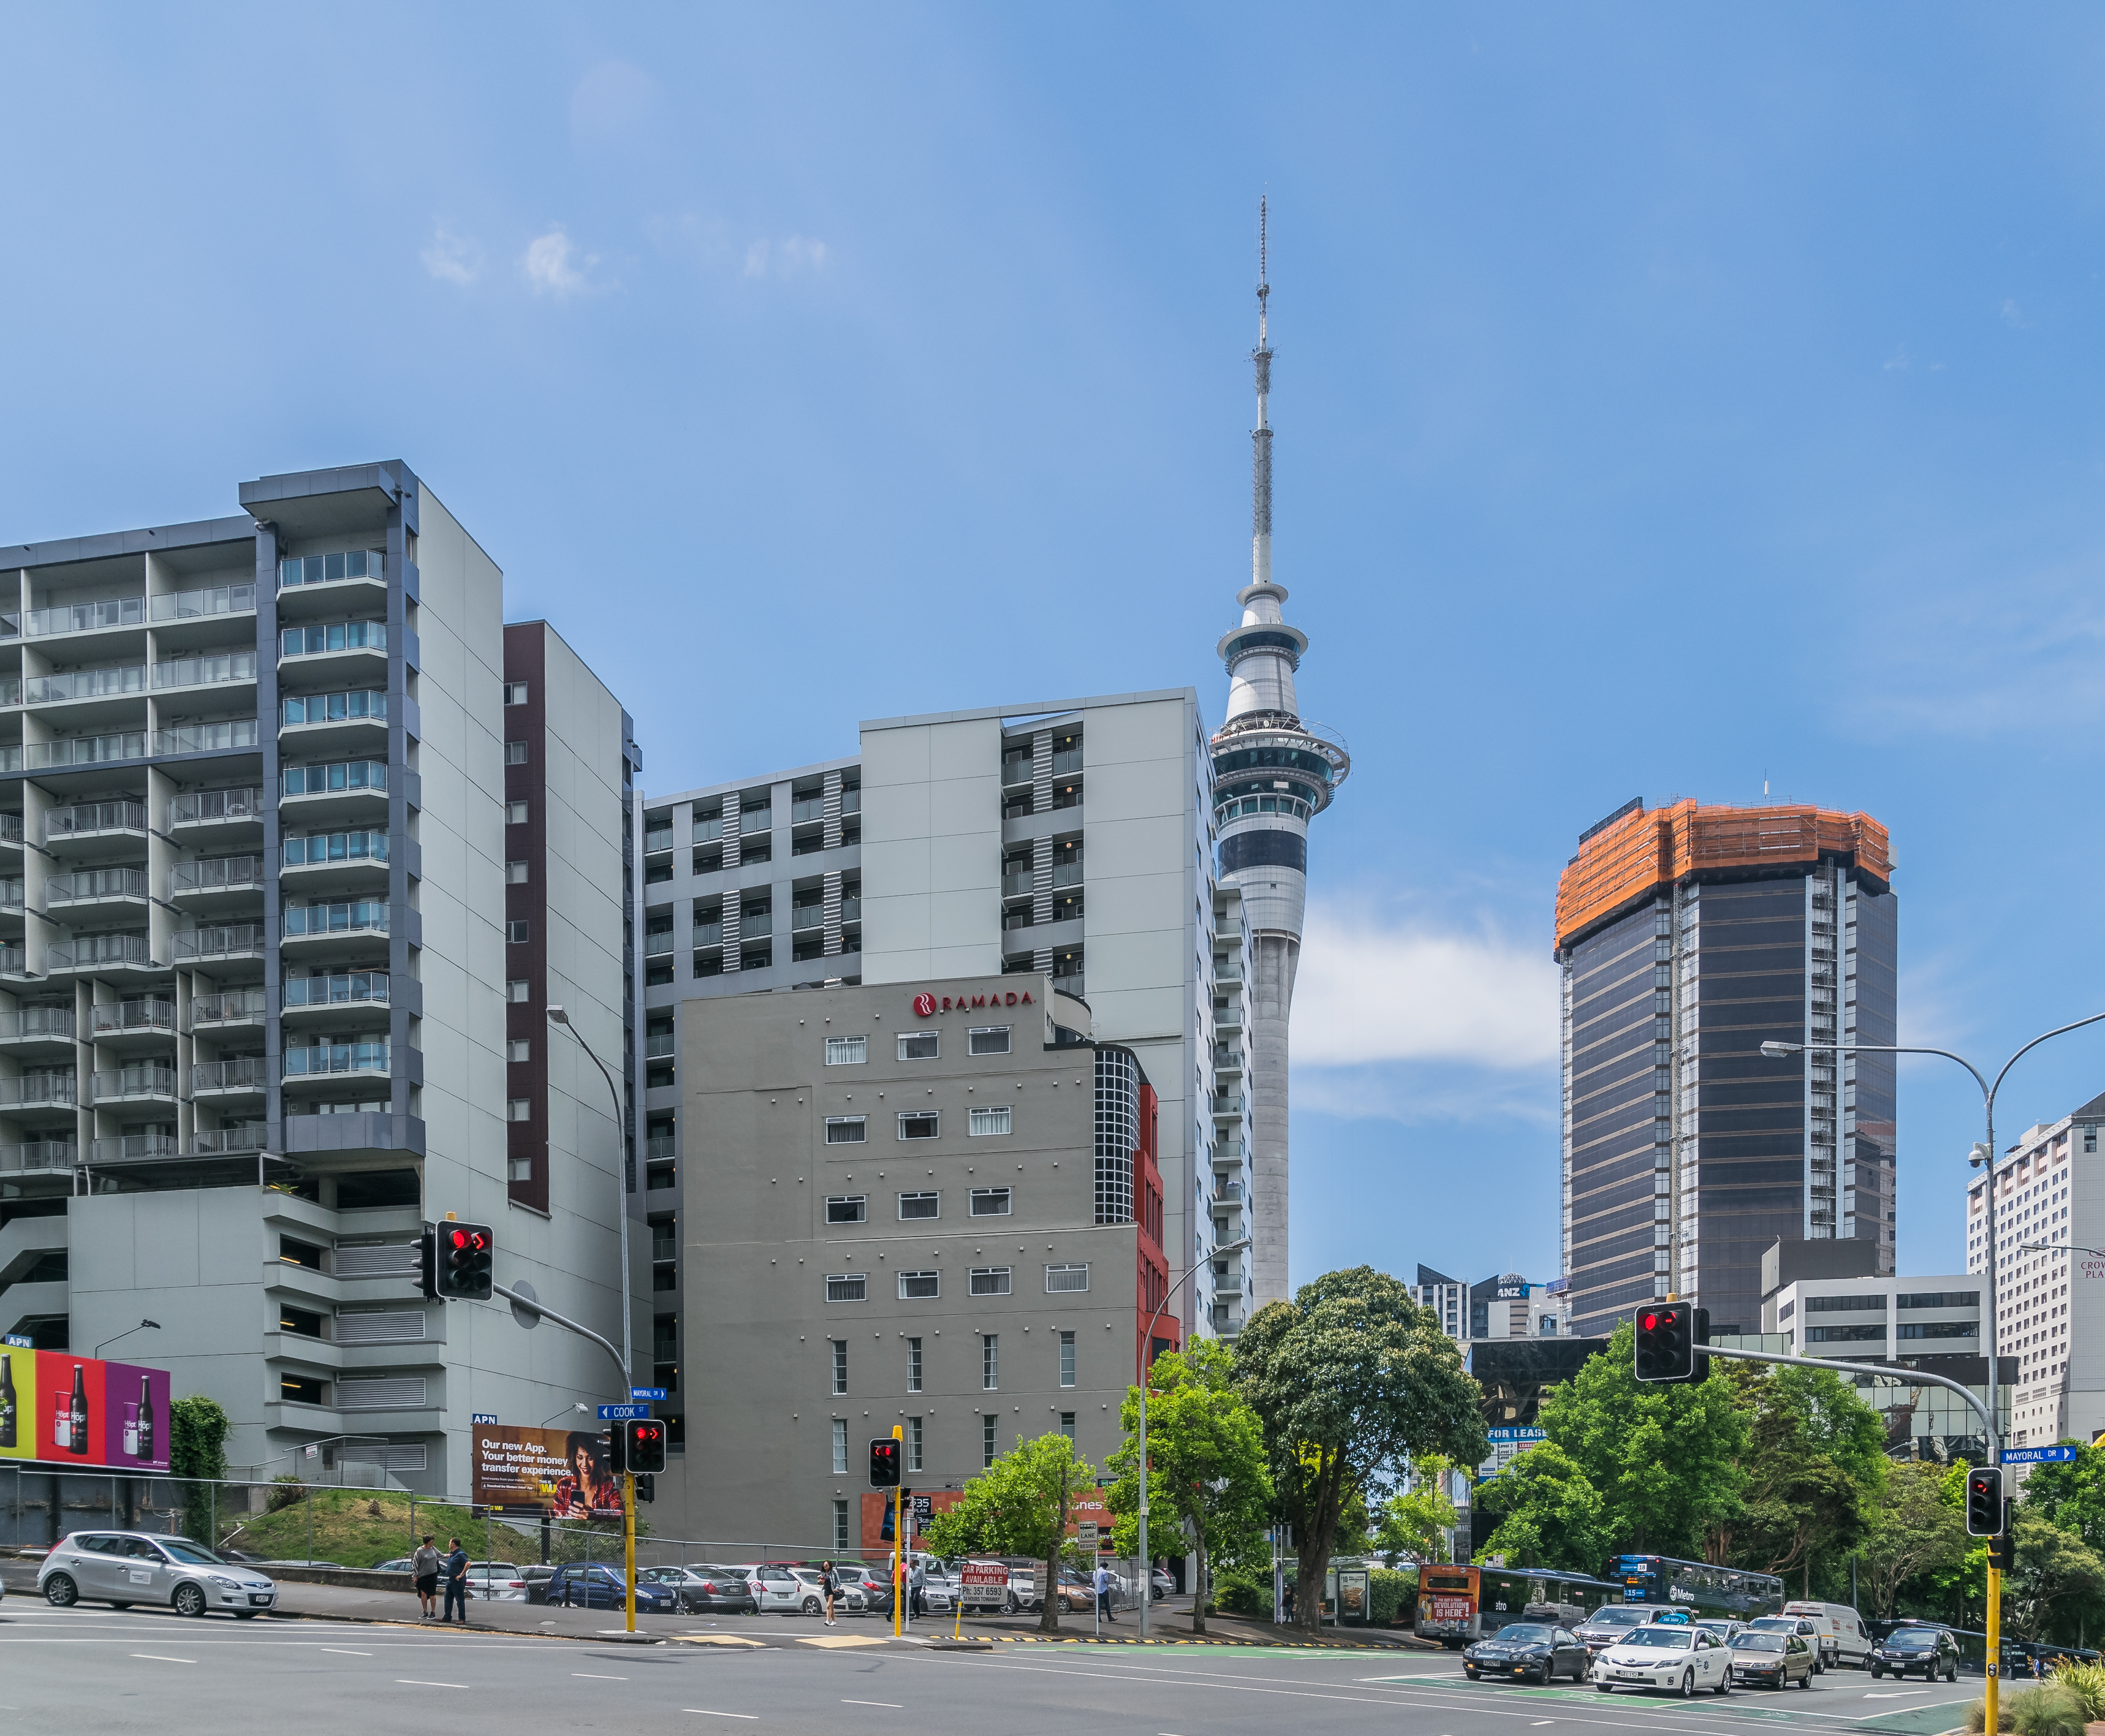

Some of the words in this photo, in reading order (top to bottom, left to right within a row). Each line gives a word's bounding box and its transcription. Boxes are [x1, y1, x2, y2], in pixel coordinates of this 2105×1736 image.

[942, 991, 1032, 1010] RAMADA
[1498, 1287, 1520, 1297] ANZ
[9, 1337, 29, 1347] APN
[56, 1410, 69, 1419] Höpt
[613, 1407, 635, 1417] COOK
[474, 1416, 495, 1424] APN
[1488, 1429, 1510, 1438] FOR
[1514, 1428, 1547, 1438] LEASE
[482, 1439, 500, 1449] Our
[525, 1442, 547, 1454] App.
[482, 1450, 504, 1460] Your
[506, 1452, 535, 1463] better
[537, 1457, 568, 1467] money
[2006, 1451, 2044, 1461] MAYORAL
[482, 1463, 520, 1473] transfer
[522, 1466, 574, 1476] experience.
[540, 1484, 556, 1493] WU
[962, 1565, 974, 1574] CAR
[976, 1566, 1008, 1575] PARKING
[965, 1575, 1003, 1584] AVAILABLE
[962, 1586, 971, 1594] Ph:
[973, 1586, 984, 1595] 357
[985, 1587, 1002, 1596] 6593
[1677, 1588, 1694, 1601] Metro
[1495, 1600, 1506, 1611] etro
